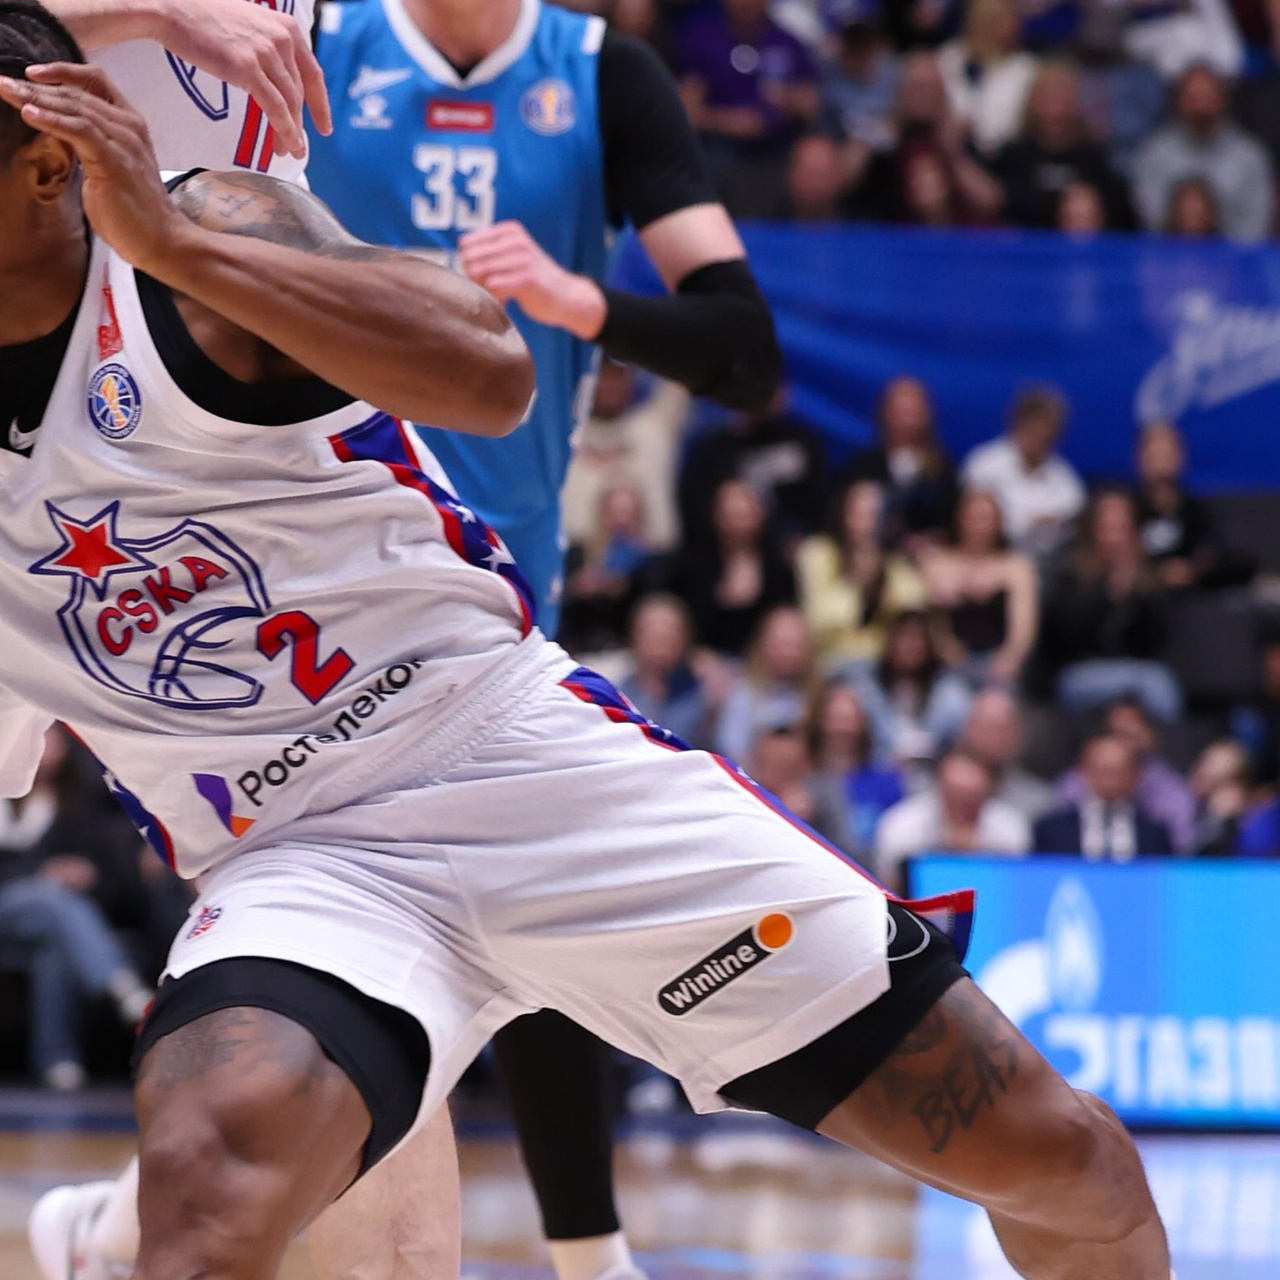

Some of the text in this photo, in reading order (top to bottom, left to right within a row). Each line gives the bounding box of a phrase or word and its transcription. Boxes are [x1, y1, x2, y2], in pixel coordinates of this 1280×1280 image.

[411, 142, 497, 230] 33
[97, 556, 229, 656] CSKA
[256, 610, 356, 705] 2
[662, 943, 758, 1009] Winline
